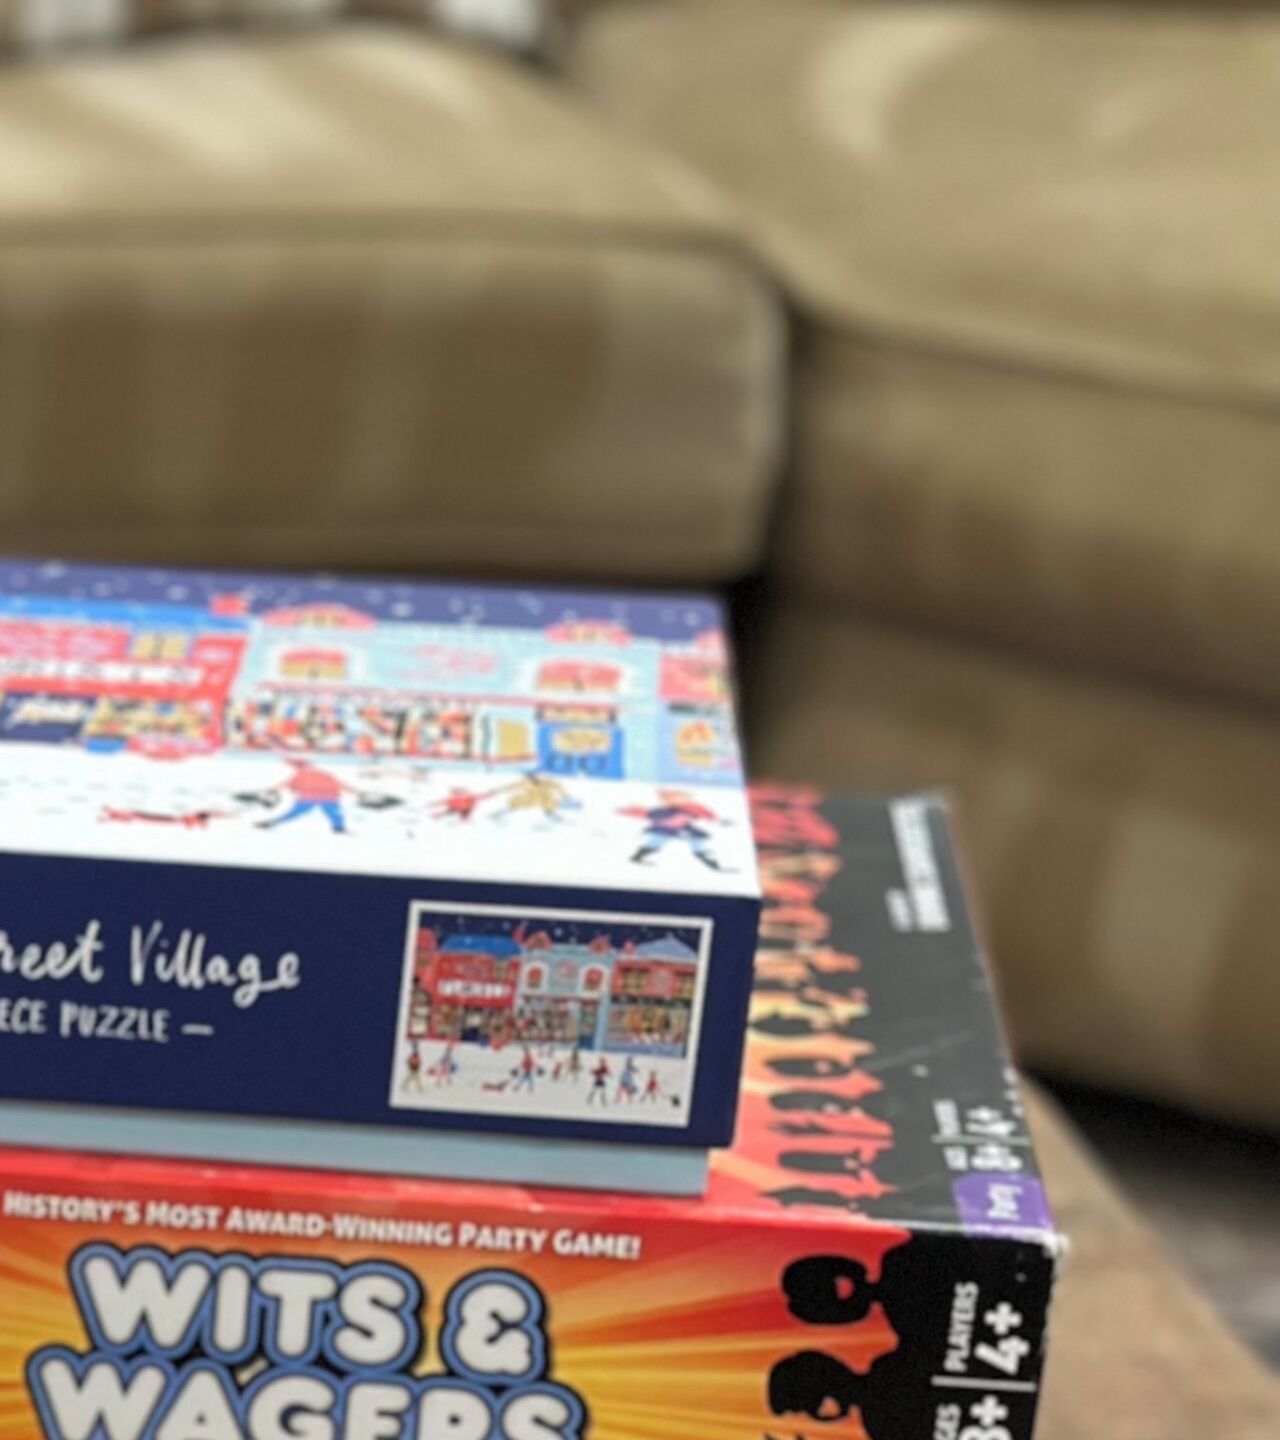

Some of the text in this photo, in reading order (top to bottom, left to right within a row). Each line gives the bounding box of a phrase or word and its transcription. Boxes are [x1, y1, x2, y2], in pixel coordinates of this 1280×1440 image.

[129, 918, 301, 1010] Village
[59, 1000, 171, 1043] PUZZLE
[3, 1190, 643, 1262] HISTORY'S MOST AWARD-WINNING PARTY GAME!
[74, 1245, 538, 1381] WITS &
[943, 1280, 980, 1373] PLAYERS
[974, 1301, 1031, 1376] 4+
